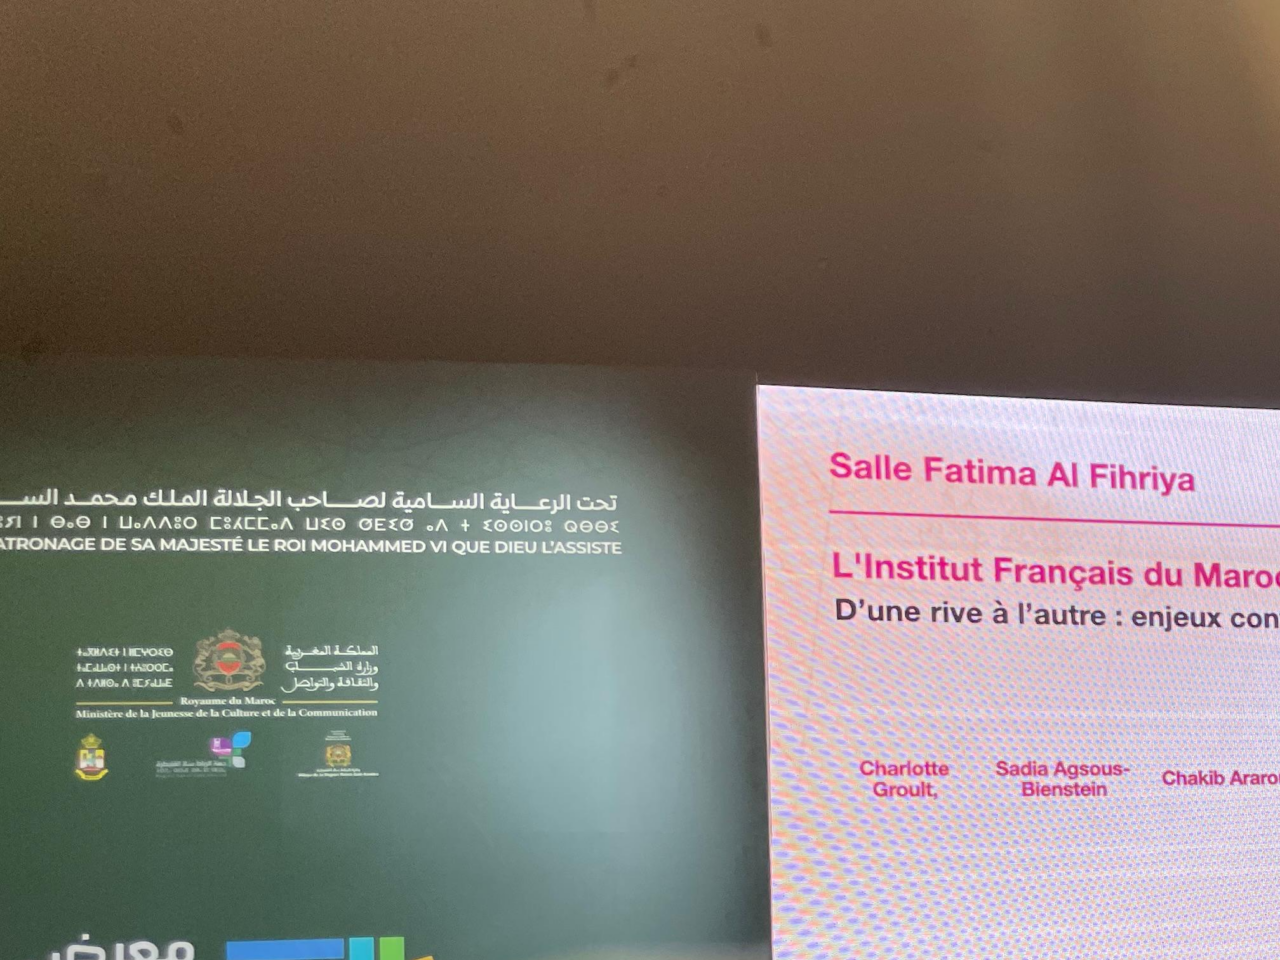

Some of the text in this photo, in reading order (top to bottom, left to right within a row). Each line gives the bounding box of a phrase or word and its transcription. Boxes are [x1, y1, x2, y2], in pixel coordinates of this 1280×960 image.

[829, 453, 1195, 495] Salle Fatima Al Fihriya
[63, 489, 618, 515] تحت الرعاية السامية لصاحب الجلالة الملك محمد
[100, 538, 127, 551] DE
[131, 538, 156, 551] SA
[161, 535, 243, 552] MAJESTÉ
[248, 539, 269, 552] LE
[275, 539, 306, 552] ROI
[312, 540, 426, 554] MOHAMMED
[430, 540, 447, 553] VI
[452, 541, 490, 555] QUE
[495, 541, 537, 554] DIEU
[833, 552, 983, 583] L'Institut
[995, 557, 1133, 591] Français
[1144, 561, 1183, 588] du
[932, 601, 983, 624] rive
[993, 601, 1009, 625] à
[1132, 606, 1222, 632] enjeux
[180, 696, 276, 707] Royaume du Maroc
[76, 708, 378, 719] Ministère de la Jeunesse de la Culture et de la Communication
[859, 760, 949, 776] Charlotte
[996, 760, 1131, 779] Sadia Agsous-
[1162, 770, 1225, 786] Chakib
[873, 781, 938, 799] Groult,
[1022, 781, 1107, 797] Bienstein
